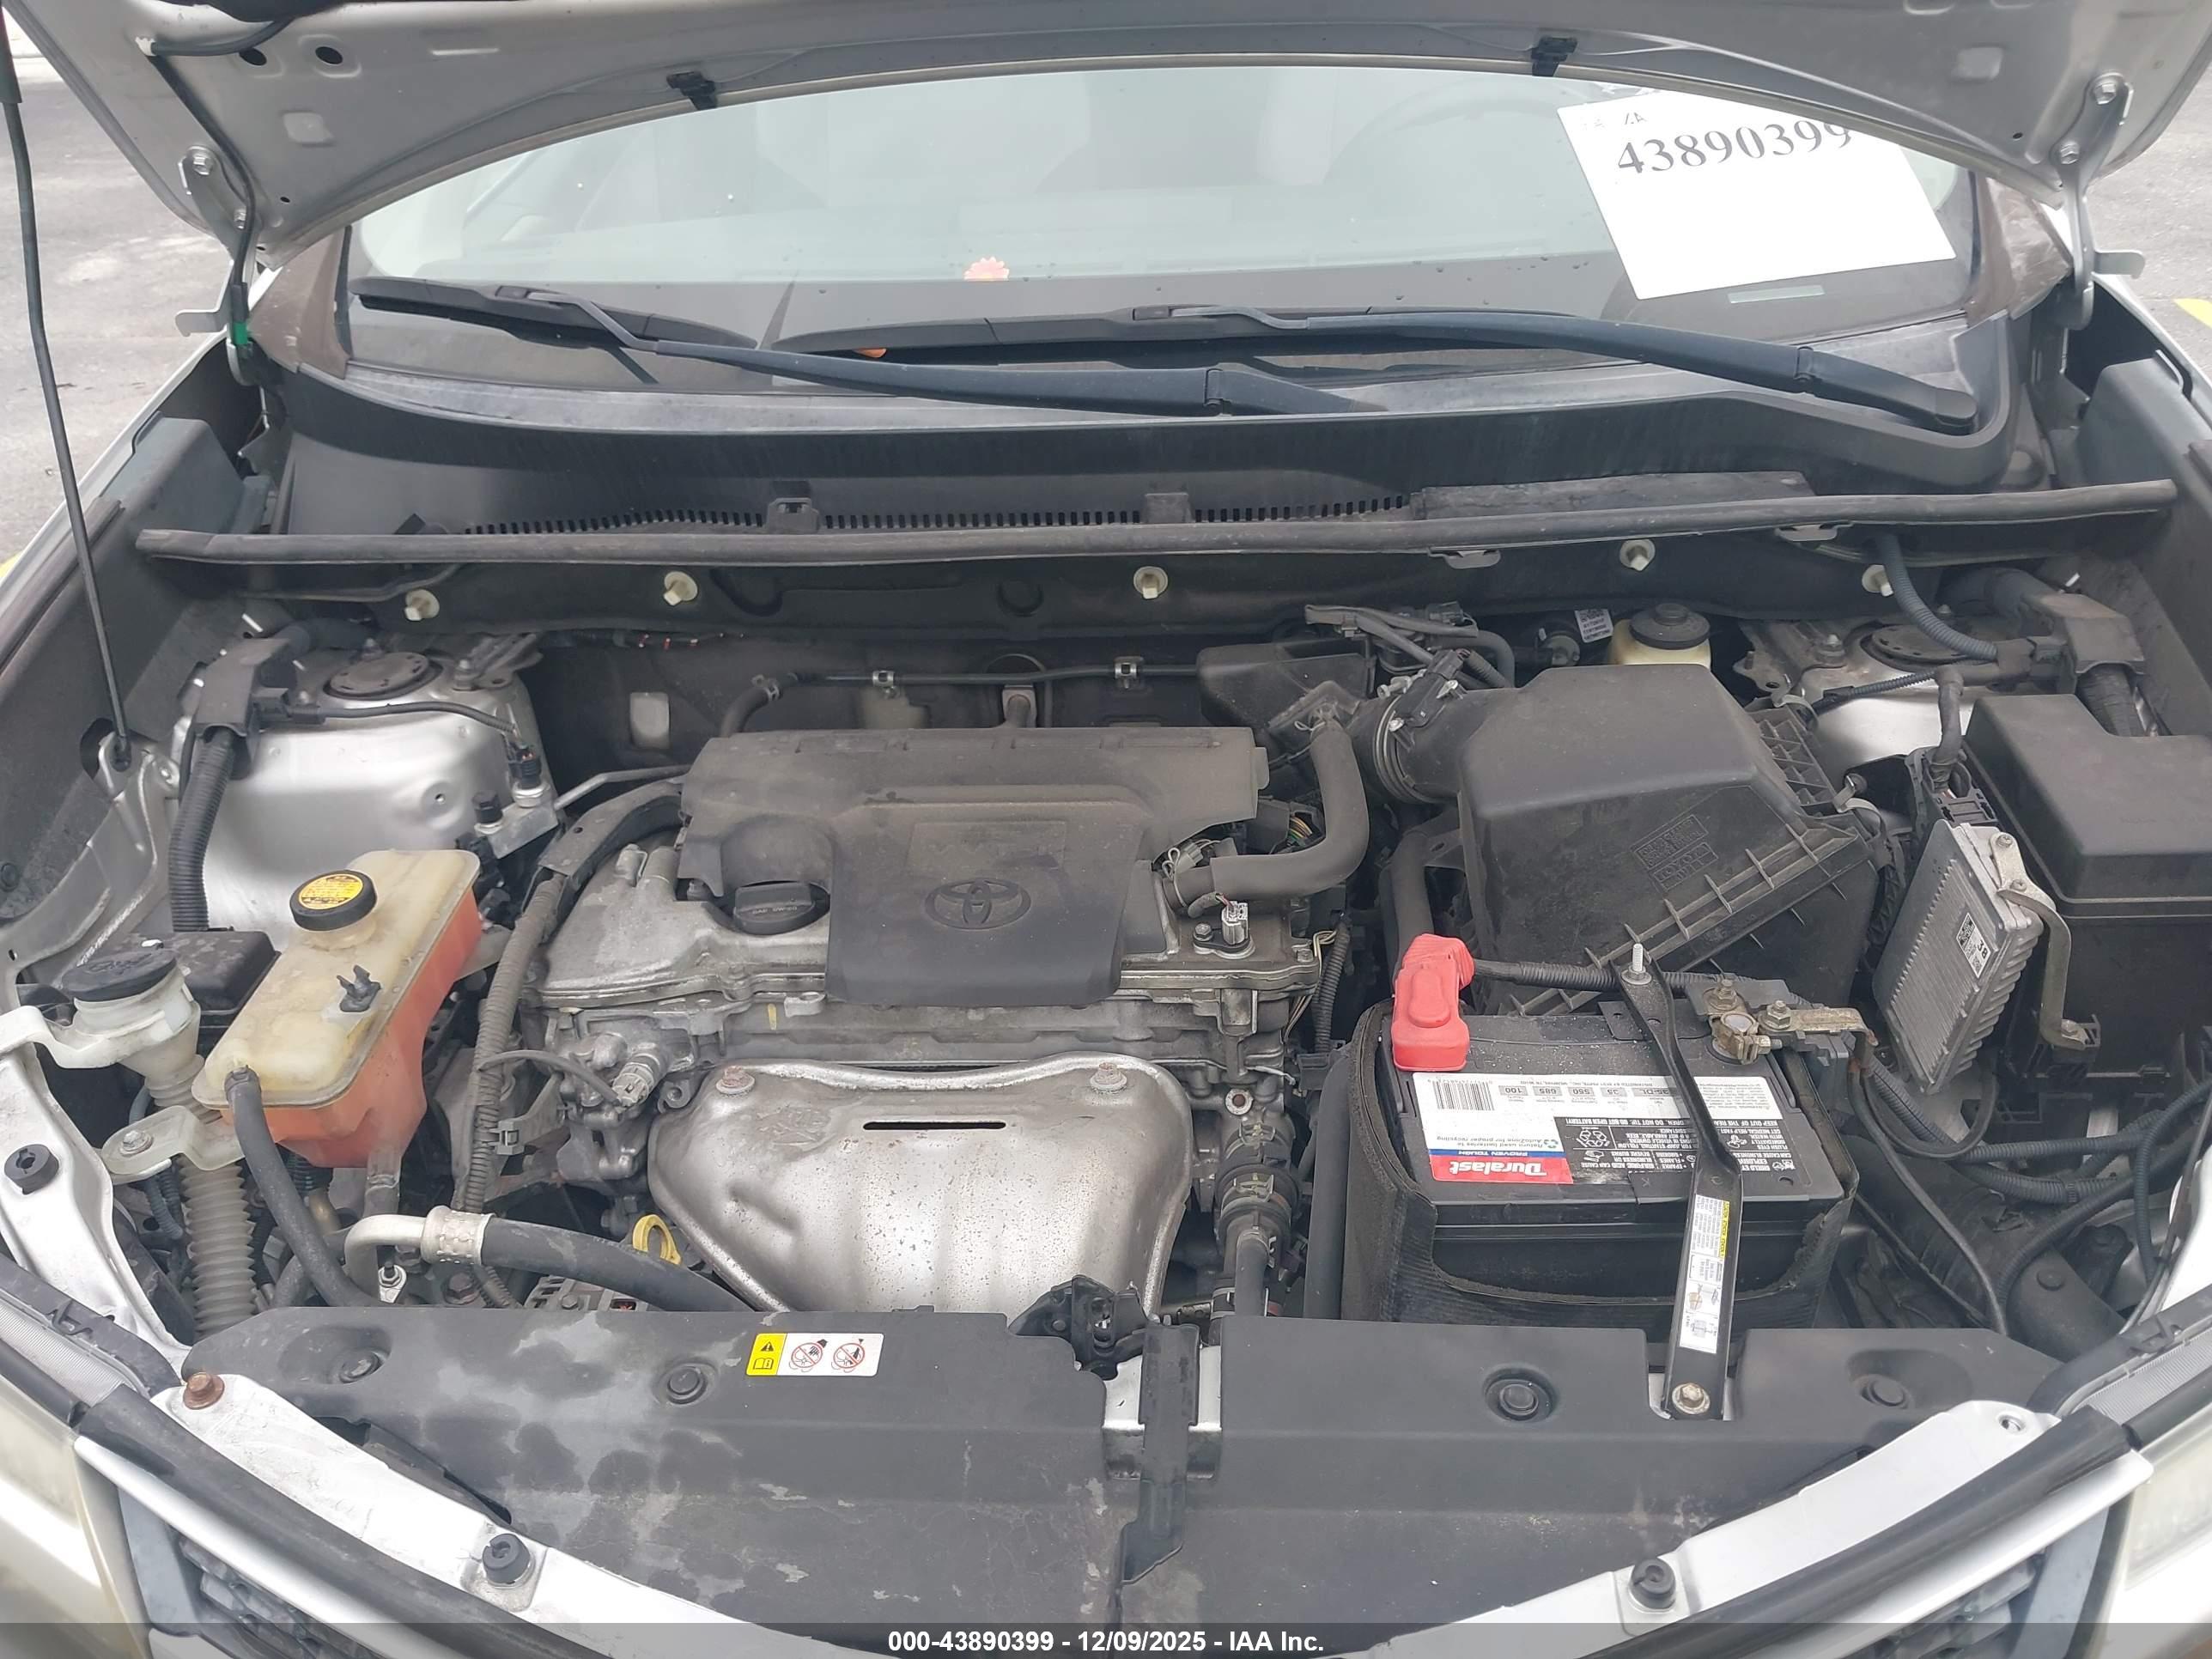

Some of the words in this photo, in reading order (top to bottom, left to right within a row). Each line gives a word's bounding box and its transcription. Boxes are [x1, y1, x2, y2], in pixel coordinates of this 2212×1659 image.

[1618, 119, 1852, 174] 43890399
[1977, 939, 1989, 959] 38
[1449, 1161, 1547, 1176] Duralast
